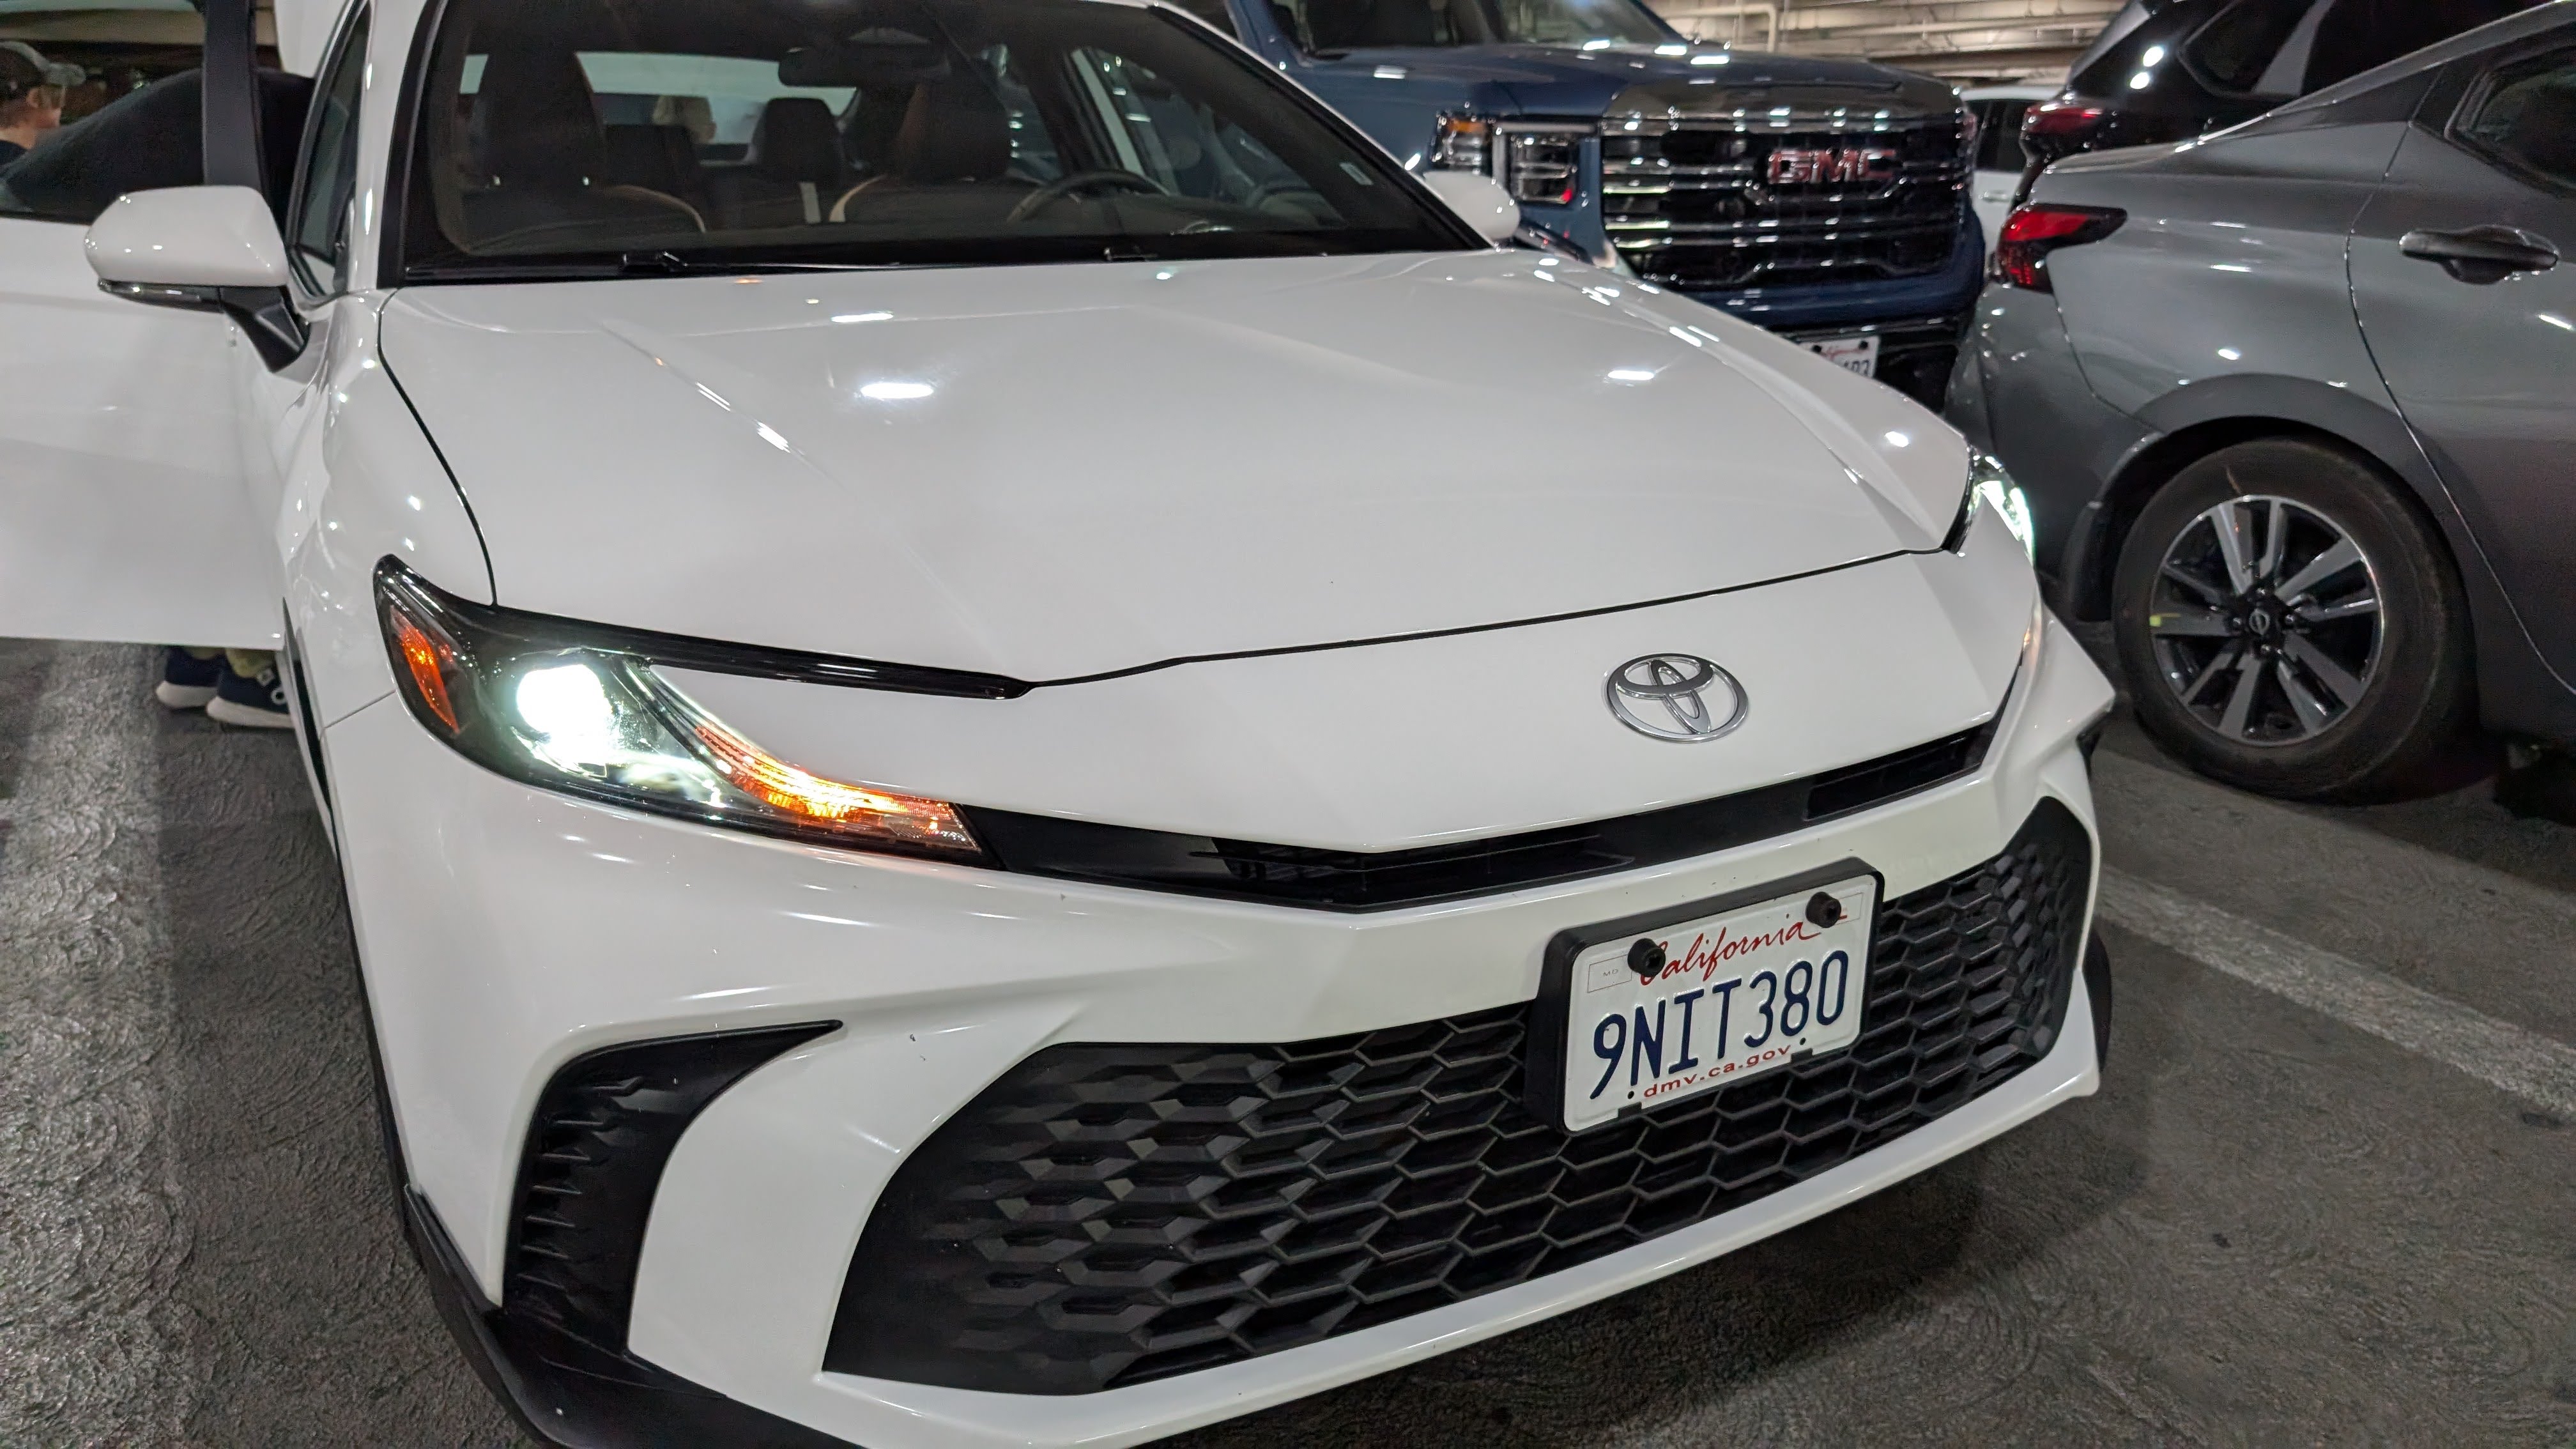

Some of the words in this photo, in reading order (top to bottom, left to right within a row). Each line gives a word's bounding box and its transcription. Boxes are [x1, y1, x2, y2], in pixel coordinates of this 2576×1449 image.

[1768, 149, 1896, 184] GMC
[1590, 950, 1849, 1100] 9NIT380
[1643, 1045, 1791, 1098] dmv.ca.gov
